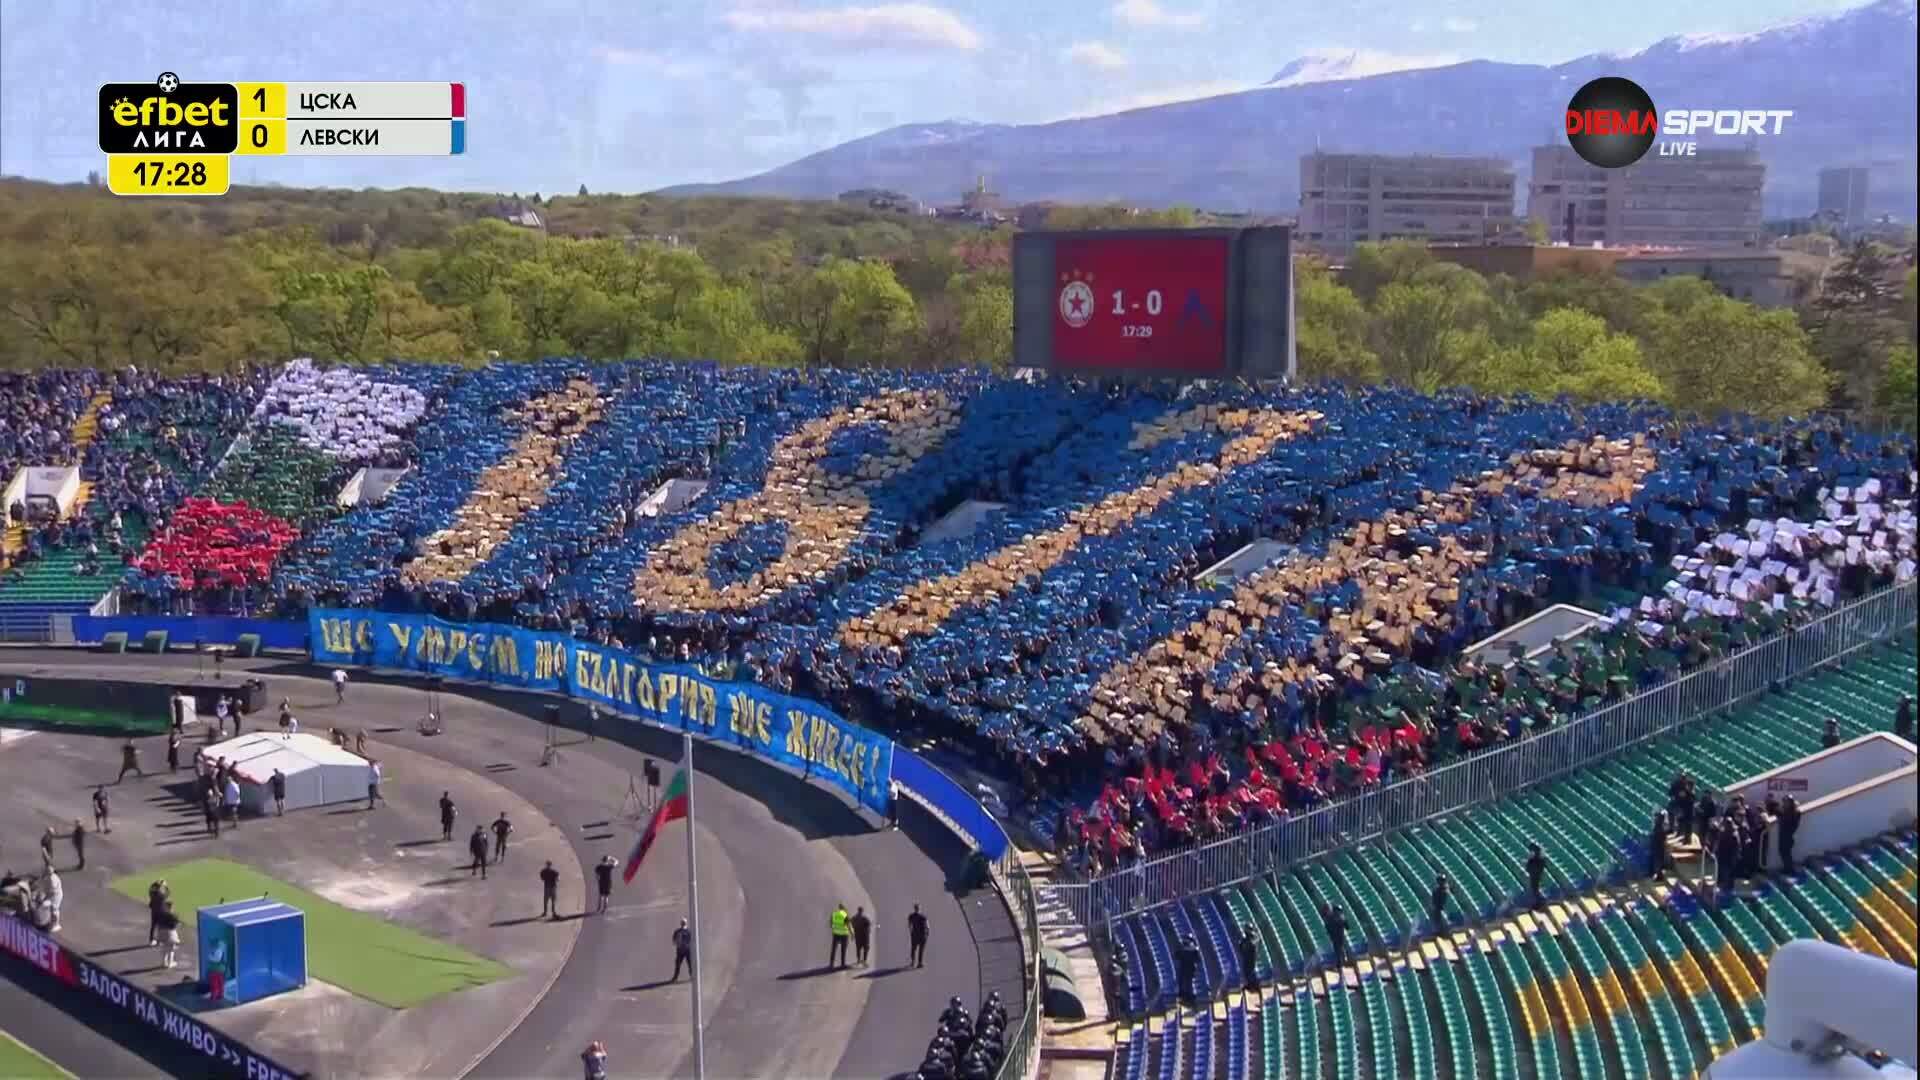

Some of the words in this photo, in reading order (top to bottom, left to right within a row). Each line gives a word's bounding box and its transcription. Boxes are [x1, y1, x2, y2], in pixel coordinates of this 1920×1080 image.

[1111, 290, 1125, 315] 1
[1146, 290, 1163, 315] 0
[80, 962, 129, 1007] ЗАЛОГ
[135, 995, 159, 1025] НА
[163, 1014, 216, 1056] ЖИВО
